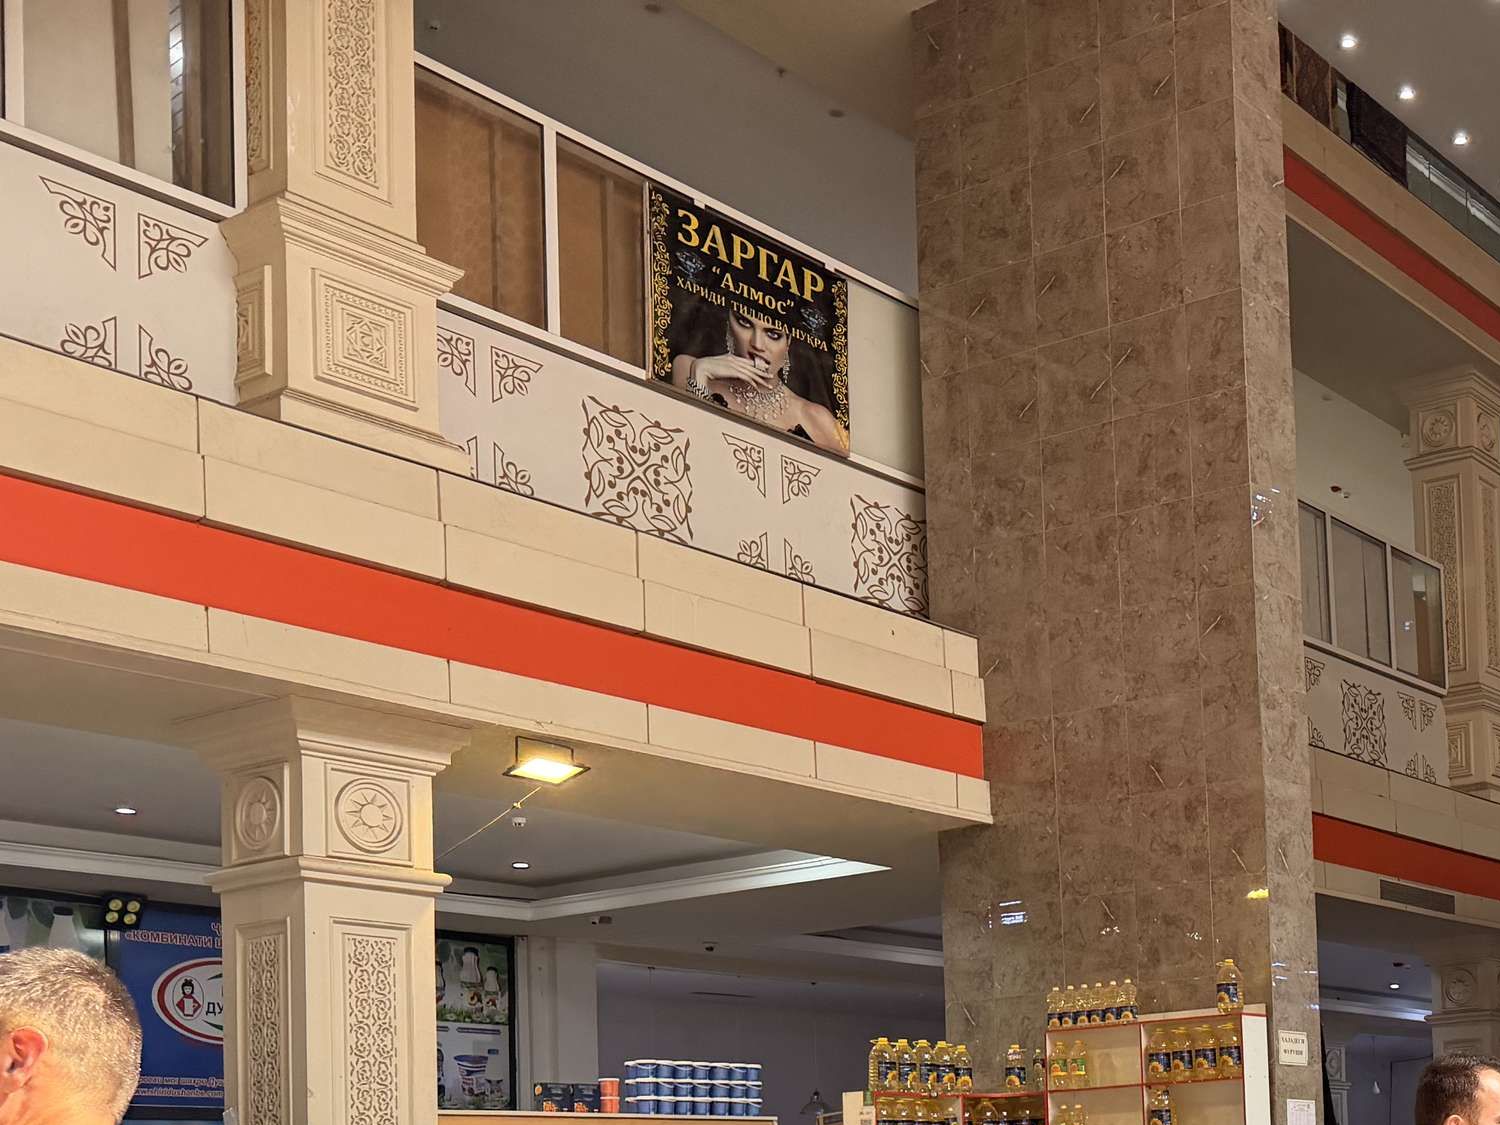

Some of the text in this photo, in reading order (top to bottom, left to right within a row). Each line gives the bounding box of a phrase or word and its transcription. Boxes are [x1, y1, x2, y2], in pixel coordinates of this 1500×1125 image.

[677, 209, 825, 302] ЗАРГАР
[676, 275, 726, 307] ХАРИДИ
[775, 318, 790, 335] ВА
[791, 326, 829, 352] НУКРА
